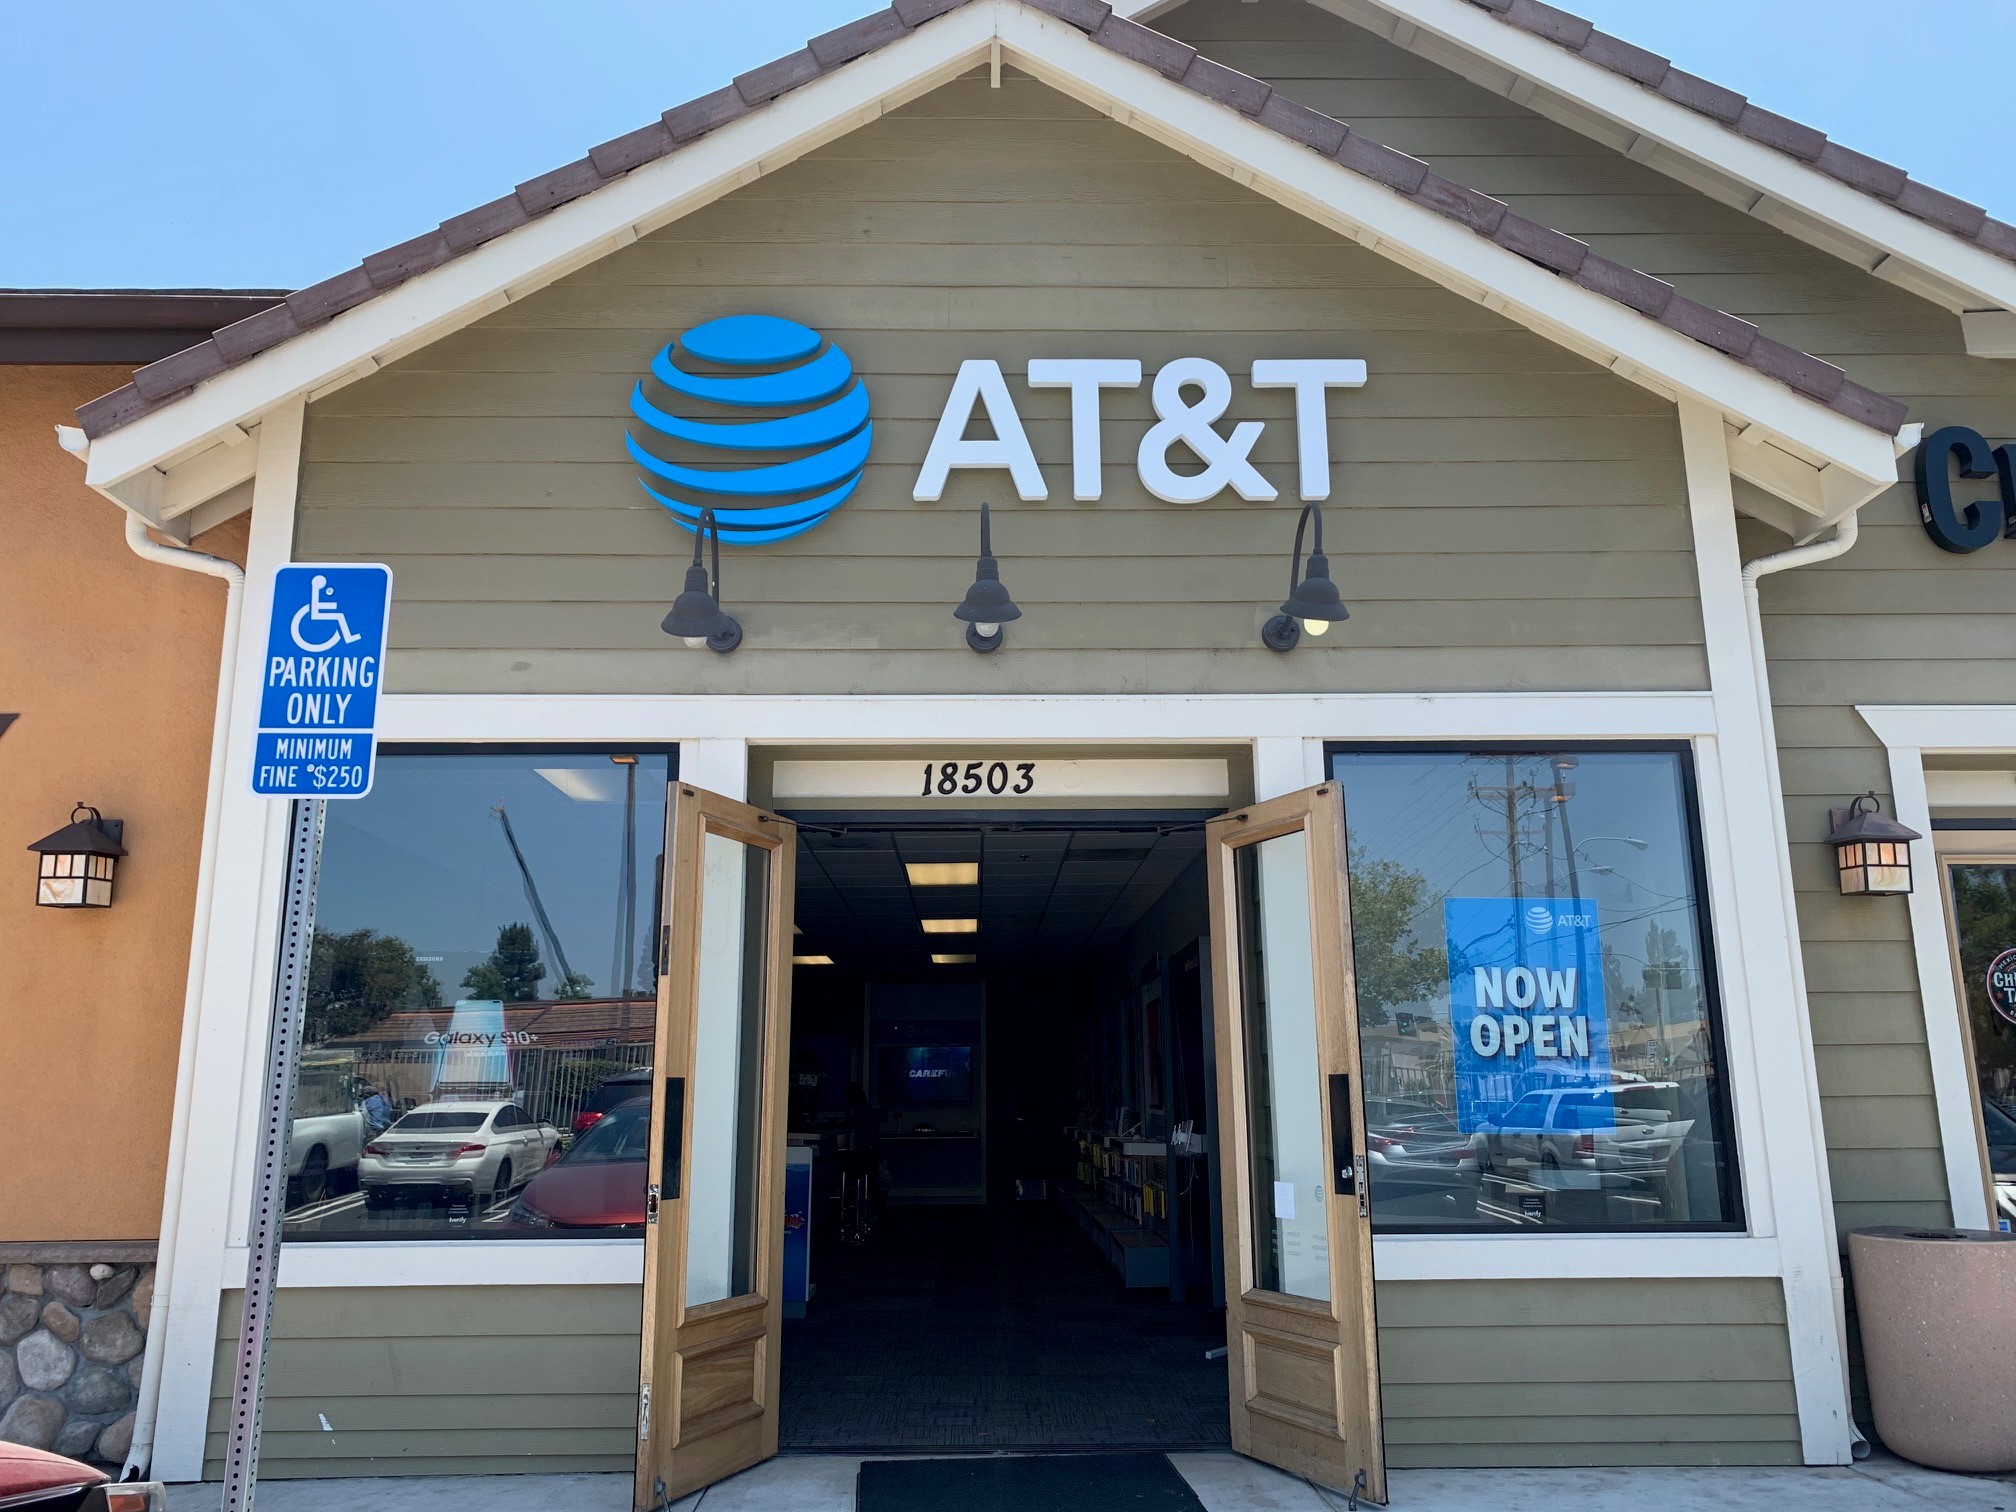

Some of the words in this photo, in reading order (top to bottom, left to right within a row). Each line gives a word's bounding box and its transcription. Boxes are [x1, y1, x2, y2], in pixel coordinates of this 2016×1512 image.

[911, 356, 1368, 504] AT&T
[269, 656, 375, 688] PARKING
[286, 692, 352, 725] ONLY
[275, 738, 353, 760] MINIMUM
[259, 765, 299, 788] FINE
[313, 764, 363, 790] $250
[921, 761, 1035, 796] 18503
[1557, 914, 1592, 927] AT&T
[1473, 966, 1577, 1009] NOW
[423, 1030, 496, 1048] Galaxy
[500, 1030, 539, 1045] S10+
[1469, 1014, 1589, 1057] OPEN
